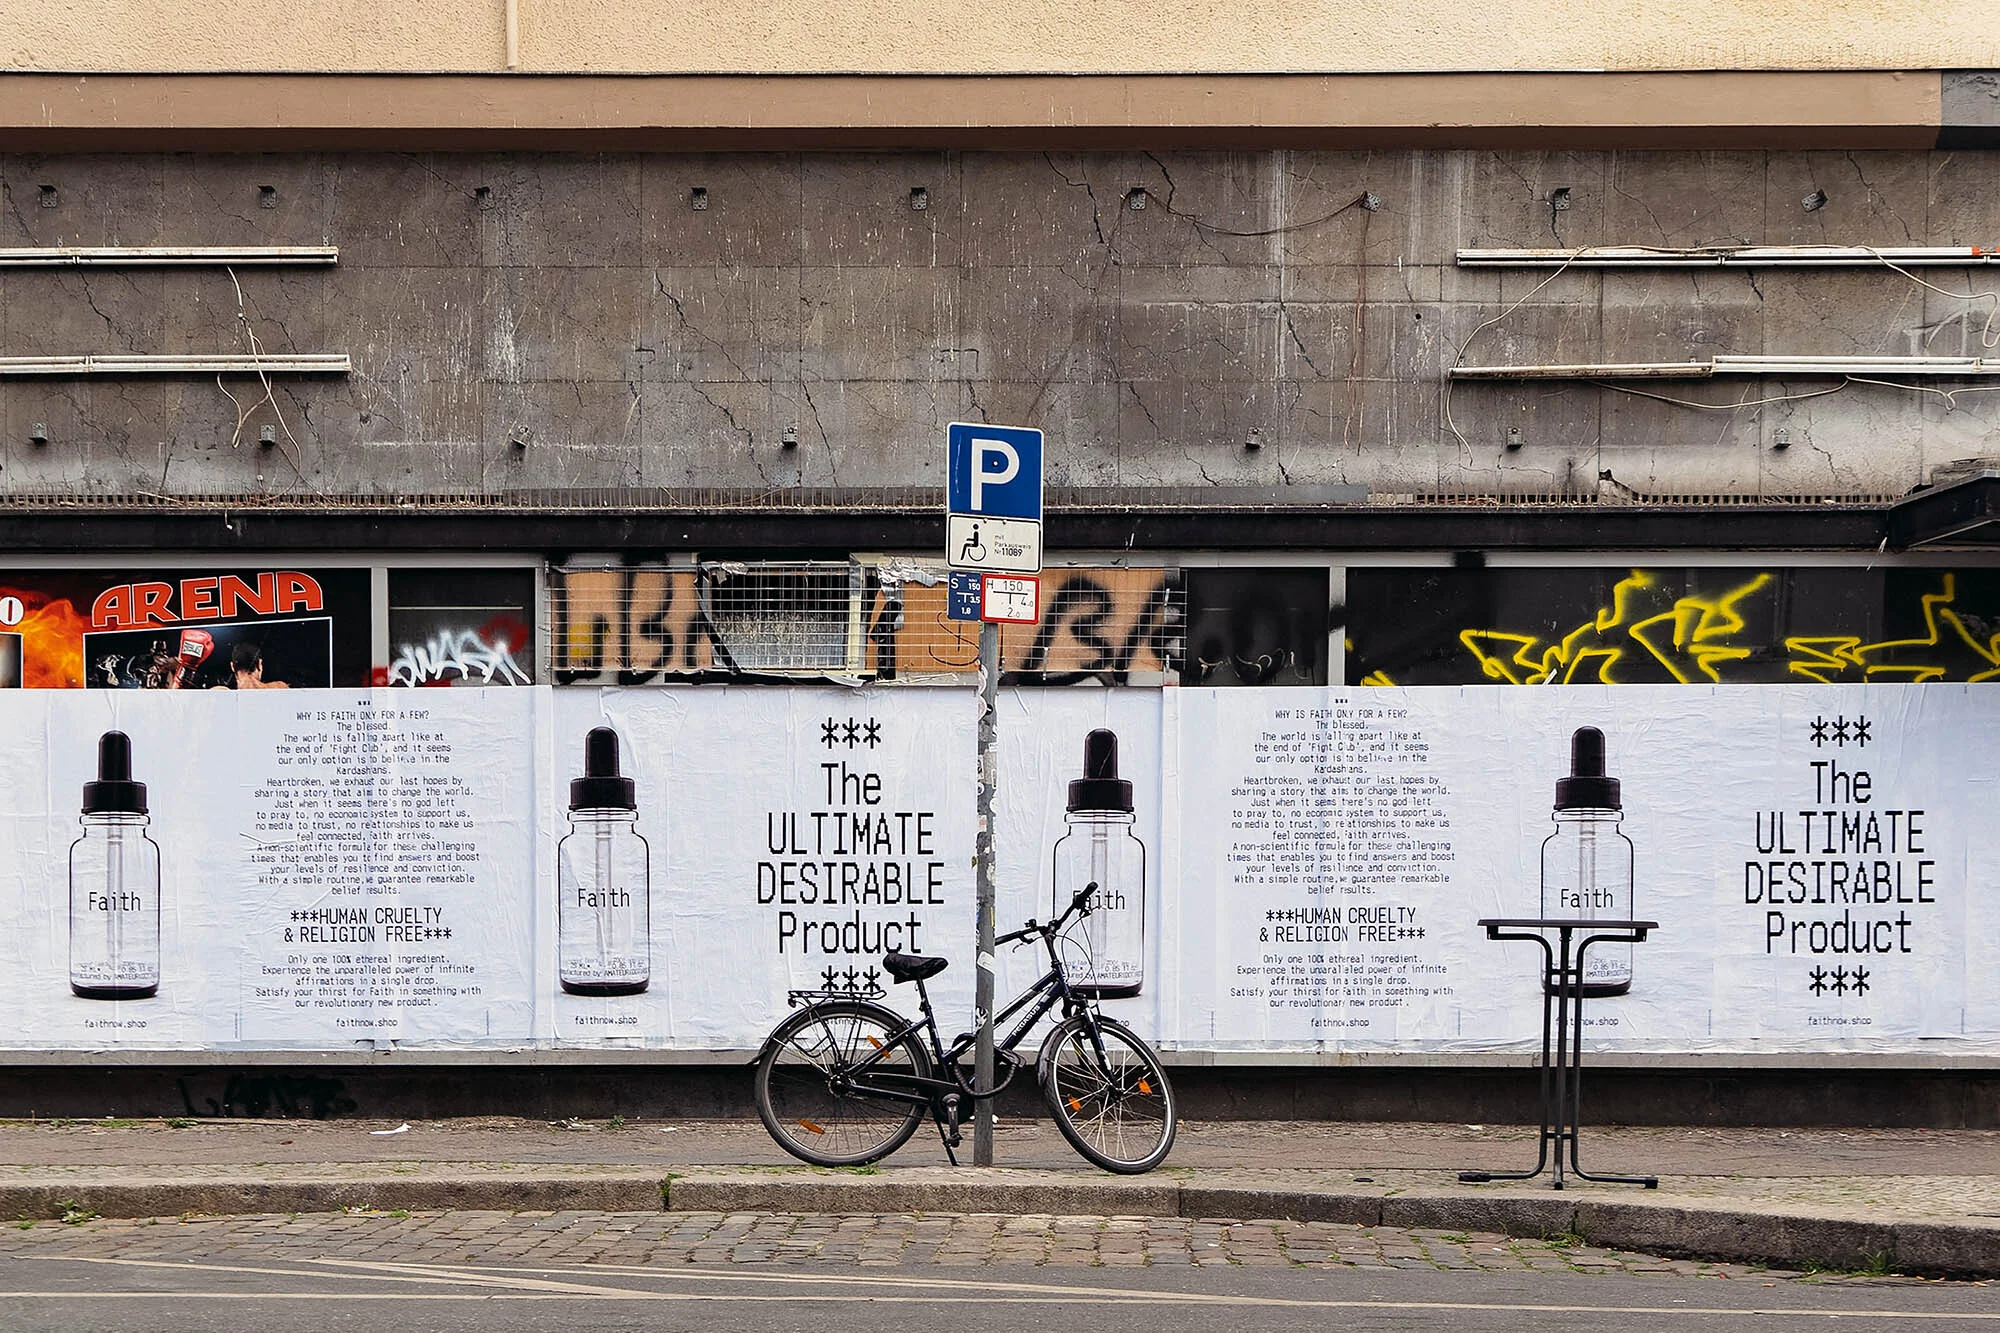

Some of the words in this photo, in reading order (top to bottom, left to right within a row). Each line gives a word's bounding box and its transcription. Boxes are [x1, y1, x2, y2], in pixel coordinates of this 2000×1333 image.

[971, 438, 1020, 511] P
[950, 578, 959, 589] S
[968, 582, 981, 591] 150
[986, 579, 994, 590] H
[1003, 580, 1023, 591] 150
[91, 571, 324, 628] ARENA
[297, 712, 311, 720] WHY
[317, 712, 326, 720] IS
[331, 712, 355, 720] FAITH
[410, 711, 429, 719] FEW?
[1359, 710, 1373, 718] FOR
[1388, 710, 1407, 718] FEW?
[337, 722, 352, 731] The
[284, 734, 298, 742] The
[303, 733, 327, 742] world
[412, 733, 430, 741] like
[277, 745, 290, 753] the
[296, 744, 310, 753] end
[298, 755, 317, 765] only
[322, 756, 351, 765] option
[435, 755, 449, 763] the
[401, 777, 418, 785] last
[423, 777, 447, 786] hopes
[820, 761, 882, 805] The
[1810, 759, 1872, 804] The
[304, 790, 327, 799] story
[333, 788, 351, 797] that
[392, 788, 421, 797] change
[426, 788, 440, 796] the
[1281, 788, 1305, 797] story
[275, 800, 293, 808] Just
[299, 799, 318, 808] when
[416, 799, 431, 808] god
[271, 812, 290, 821] pray
[269, 821, 293, 830] media
[313, 822, 340, 830] trust,
[1290, 821, 1317, 829] trust,
[297, 832, 313, 841] feel
[767, 812, 934, 855] ULTIMATE
[1756, 811, 1925, 854] ULTIMATE
[374, 842, 387, 850] for
[393, 842, 416, 851] these
[252, 854, 275, 862] times
[281, 854, 299, 863] that
[343, 855, 358, 864] you
[375, 853, 393, 861] find
[437, 853, 451, 861] and
[456, 853, 479, 861] boost
[1227, 853, 1251, 861] times
[271, 867, 289, 875] your
[295, 864, 324, 873] levels
[393, 864, 408, 872] and
[1272, 864, 1300, 872] levels
[259, 876, 279, 884] With
[293, 875, 322, 884] simple
[757, 862, 944, 905] DESIRABLE
[1745, 860, 1936, 904] DESIRABLE
[88, 891, 141, 911] Faith
[578, 887, 630, 908] Faith
[1560, 888, 1614, 908] Faith
[375, 908, 441, 924] CRUELTY
[1349, 908, 1415, 923] CRUELTY
[284, 928, 293, 942] &
[300, 926, 375, 942] RELIGION
[778, 910, 922, 955] Product
[1260, 927, 1268, 942] &
[1276, 926, 1347, 942] RELIGION
[1766, 909, 1912, 954] Product
[288, 955, 308, 964] Only
[316, 966, 330, 974] the
[396, 967, 419, 975] power
[1368, 967, 1392, 975] power
[381, 977, 410, 986] single
[415, 977, 438, 986] drop.
[1353, 976, 1382, 985] single
[1387, 976, 1410, 985] drop.
[294, 989, 313, 998] your
[319, 987, 346, 996] thirst
[353, 987, 365, 996] for
[85, 1018, 148, 1029] faithnow.shop
[575, 1015, 638, 1026] faithnow.shop
[1012, 1003, 1042, 1037] PEGASUS
[1807, 1015, 1872, 1026] faithnow.shop
